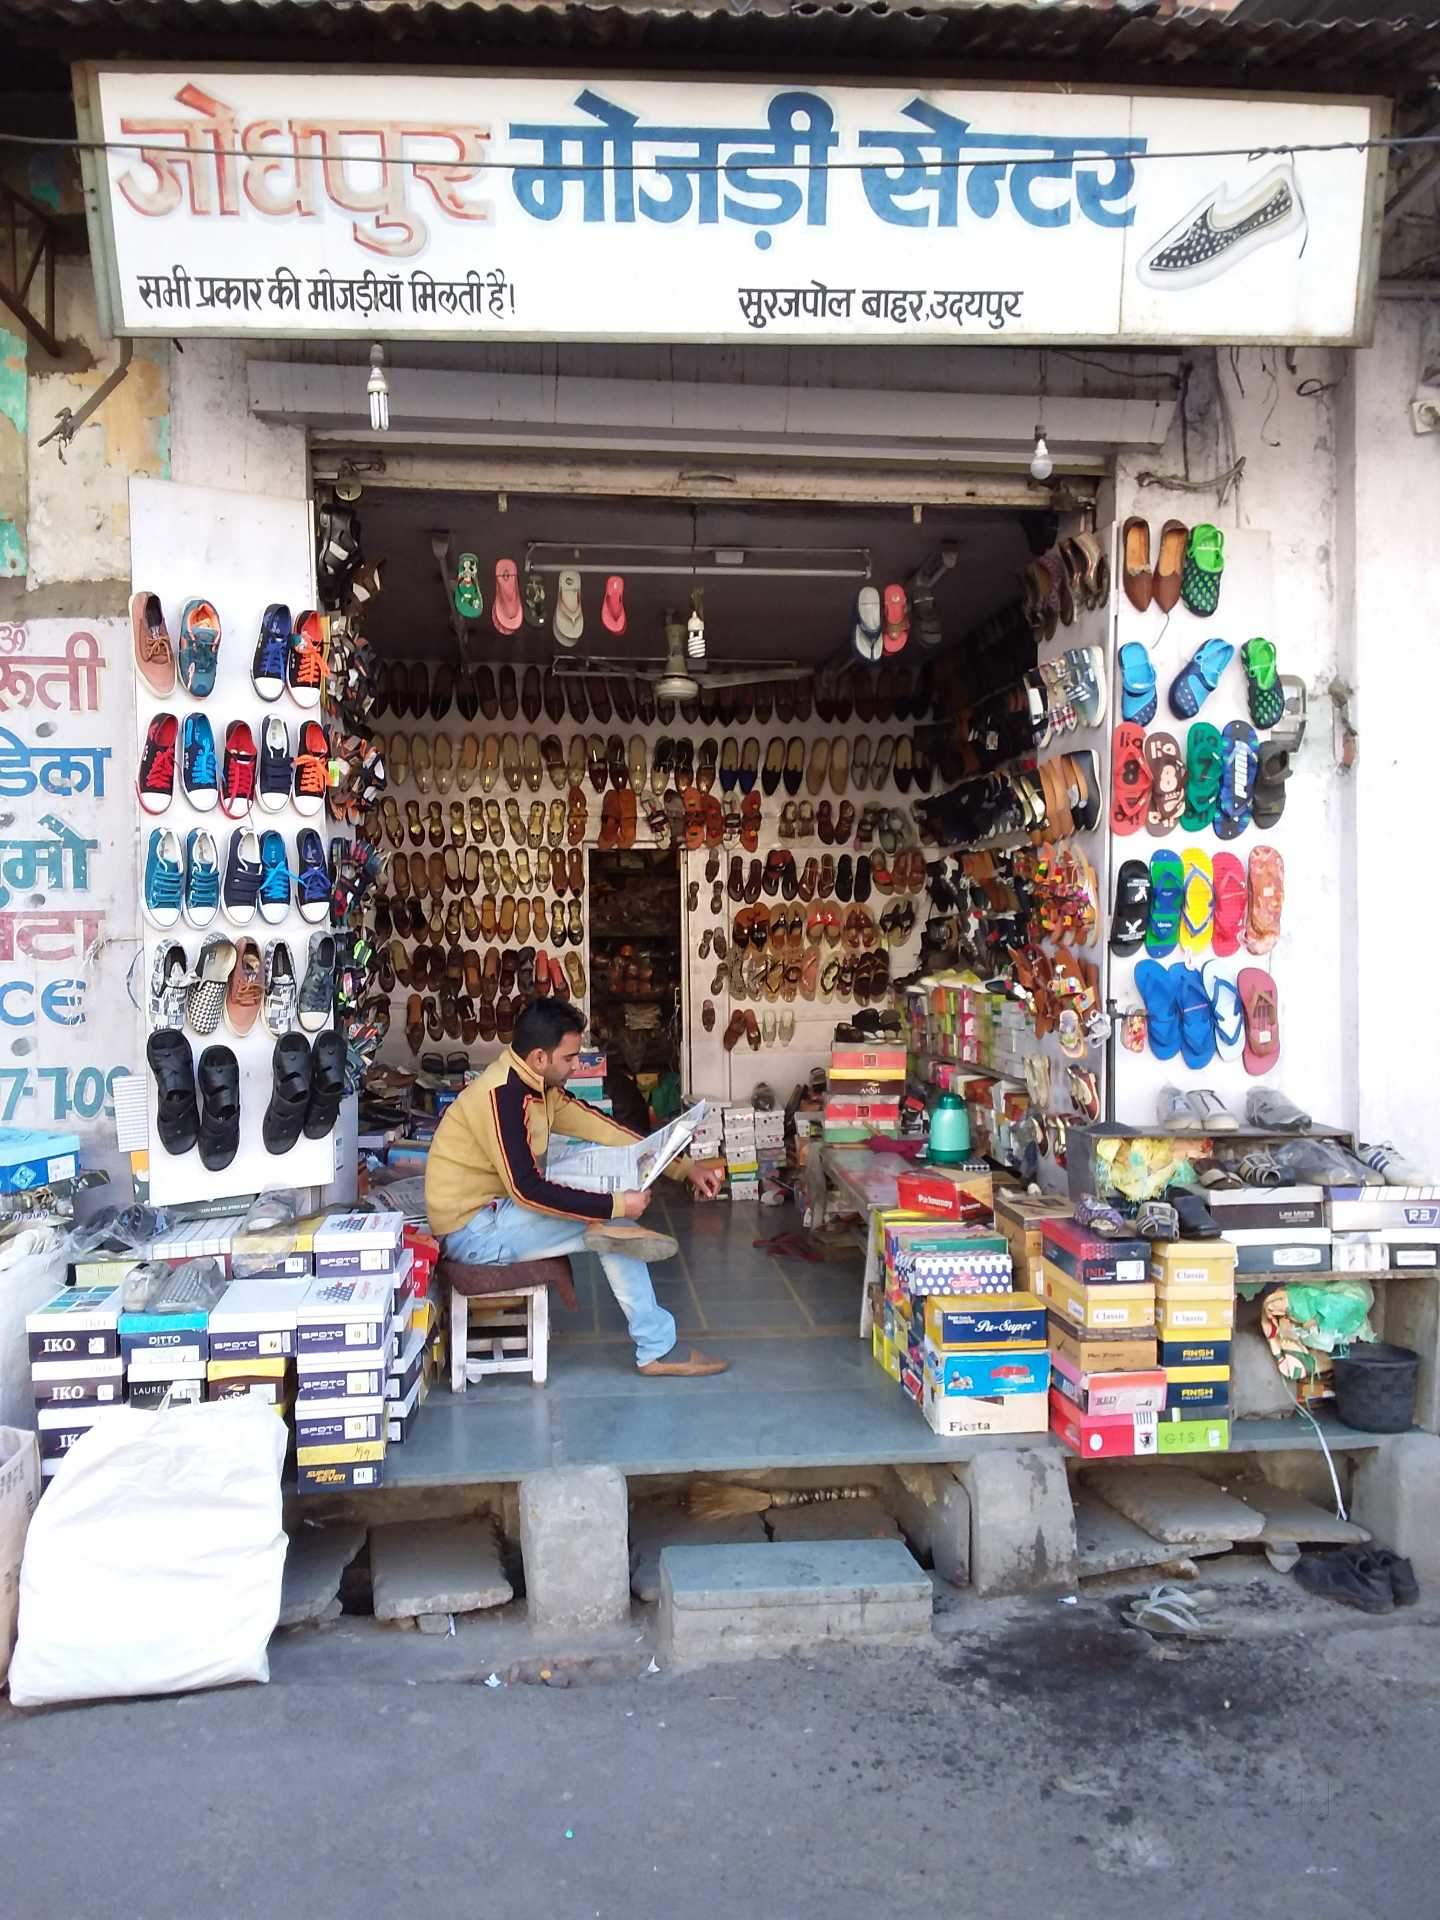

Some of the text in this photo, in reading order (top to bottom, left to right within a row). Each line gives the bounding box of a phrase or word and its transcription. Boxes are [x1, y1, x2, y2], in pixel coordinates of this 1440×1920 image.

[117, 83, 1147, 257] जोधपुर मोजड़ी सेन्टर
[136, 265, 191, 309] सभी
[195, 276, 264, 311] प्रकार
[267, 266, 302, 310] की
[408, 270, 485, 316] मिलती
[149, 1336, 181, 1345] DITTO
